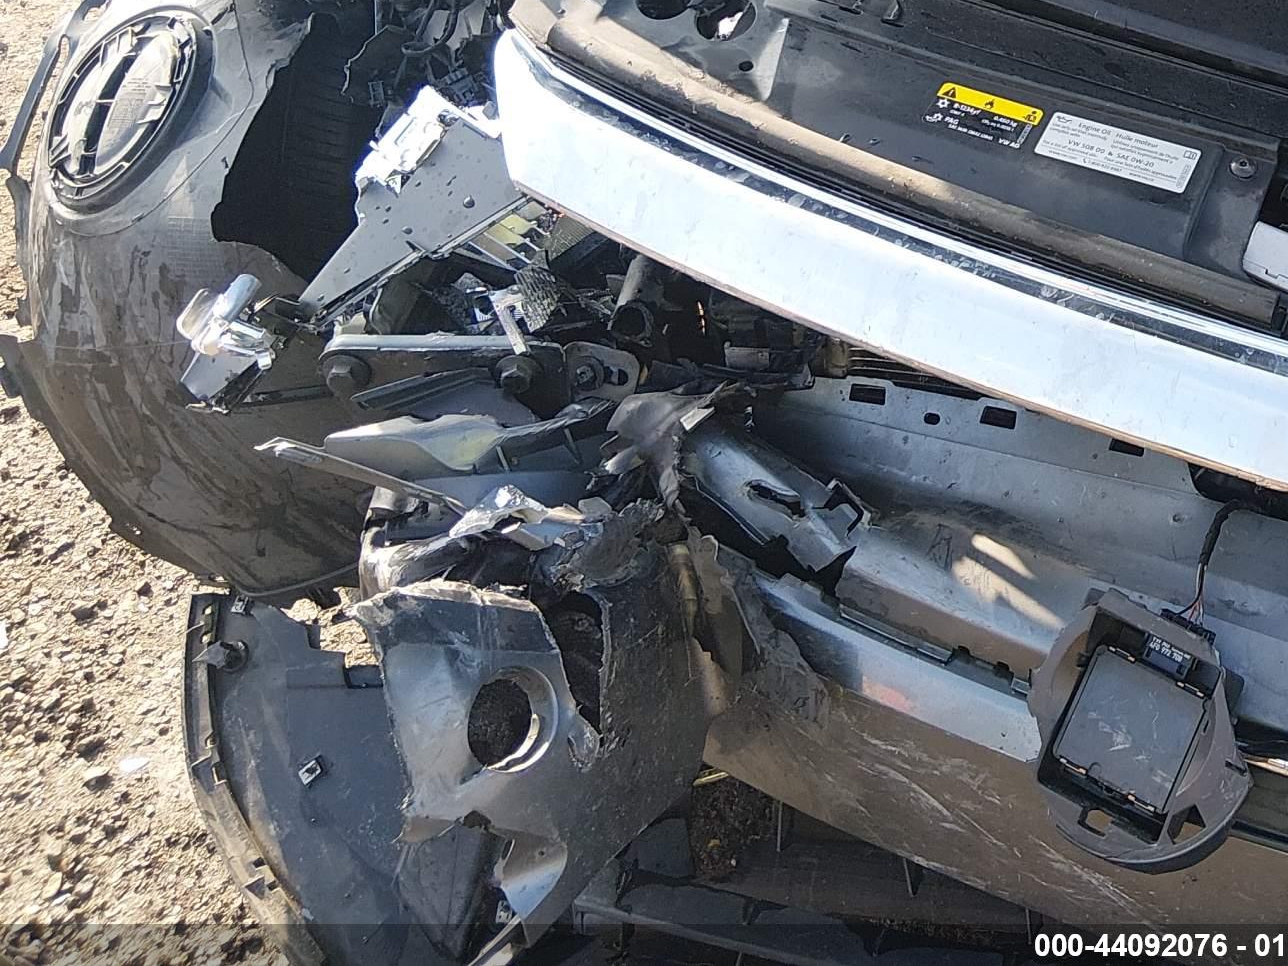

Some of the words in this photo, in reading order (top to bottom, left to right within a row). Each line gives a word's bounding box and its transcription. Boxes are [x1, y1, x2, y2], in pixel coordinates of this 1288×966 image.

[952, 103, 981, 116] R-1234yf
[1077, 123, 1101, 133] Engine
[1115, 133, 1134, 141] Huile
[1134, 138, 1159, 148] moteur
[1130, 157, 1155, 168] 0W-20
